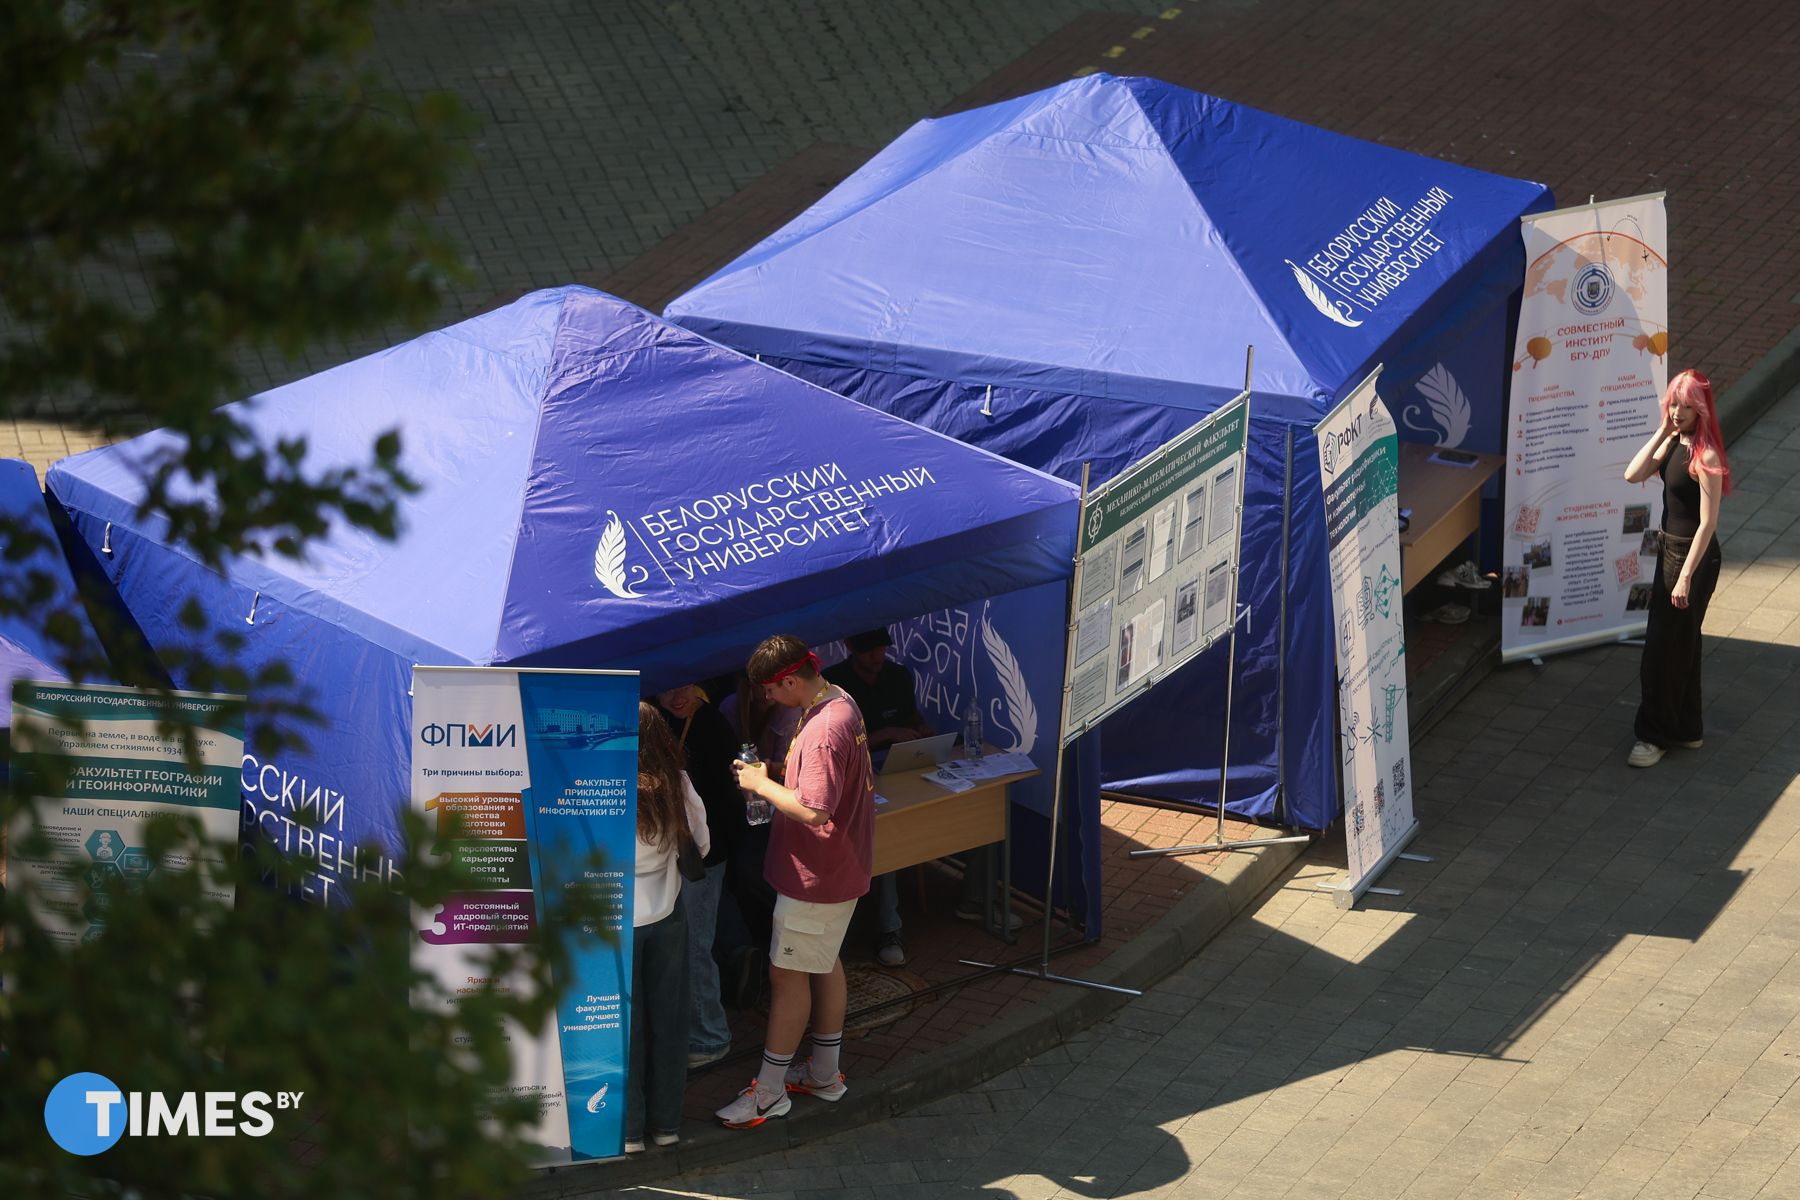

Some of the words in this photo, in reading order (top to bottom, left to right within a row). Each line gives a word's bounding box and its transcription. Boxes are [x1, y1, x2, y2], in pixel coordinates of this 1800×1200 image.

[1307, 196, 1402, 277] БЕЛОРУССКИЙ
[1332, 186, 1453, 292] ГОСУДАРСТВЕННЫЙ
[1356, 229, 1445, 306] УНИВЕРСИТЕТ
[1557, 317, 1625, 336] СОВМЕСТНЫЙ
[1565, 334, 1613, 348] ИНСТИТУТ
[1570, 348, 1611, 361] БГУ-ДПУ
[1203, 418, 1239, 450] ФАКУЛЬТЕТ
[1337, 413, 1362, 454] РФКТ
[641, 462, 847, 537] БЕЛОРУССКИЙ
[658, 467, 936, 558] ГОСУДАРСТВЕННЫЙ
[673, 506, 870, 579] УНИВЕРСИТЕТ
[36, 692, 92, 703] БЕЛОРУССКИЙ
[421, 723, 516, 747] ФПМИ
[110, 743, 155, 752] стихиями
[144, 770, 223, 787] ГЕОГРАФИИ
[422, 768, 439, 777] Три
[441, 769, 482, 777] причины
[485, 769, 523, 777] выбора:
[65, 779, 75, 789] И
[78, 779, 208, 798] ГЕОИНФОРМАТИКИ
[575, 779, 627, 787] ФАКУЛЬТЕТ
[565, 788, 626, 797] ПРИКЛАДНОЙ
[557, 798, 617, 806] МАТЕМАТИКИ
[63, 807, 94, 817] НАШИ
[539, 807, 607, 816] ИНФОРМАТИКИ
[609, 808, 626, 816] БГУ
[463, 902, 519, 910] постоянный
[454, 913, 500, 921] кадровый
[586, 994, 620, 1003] Лучший
[575, 1004, 620, 1013] факультет
[585, 1013, 620, 1022] лучшего
[563, 1022, 620, 1032] университета
